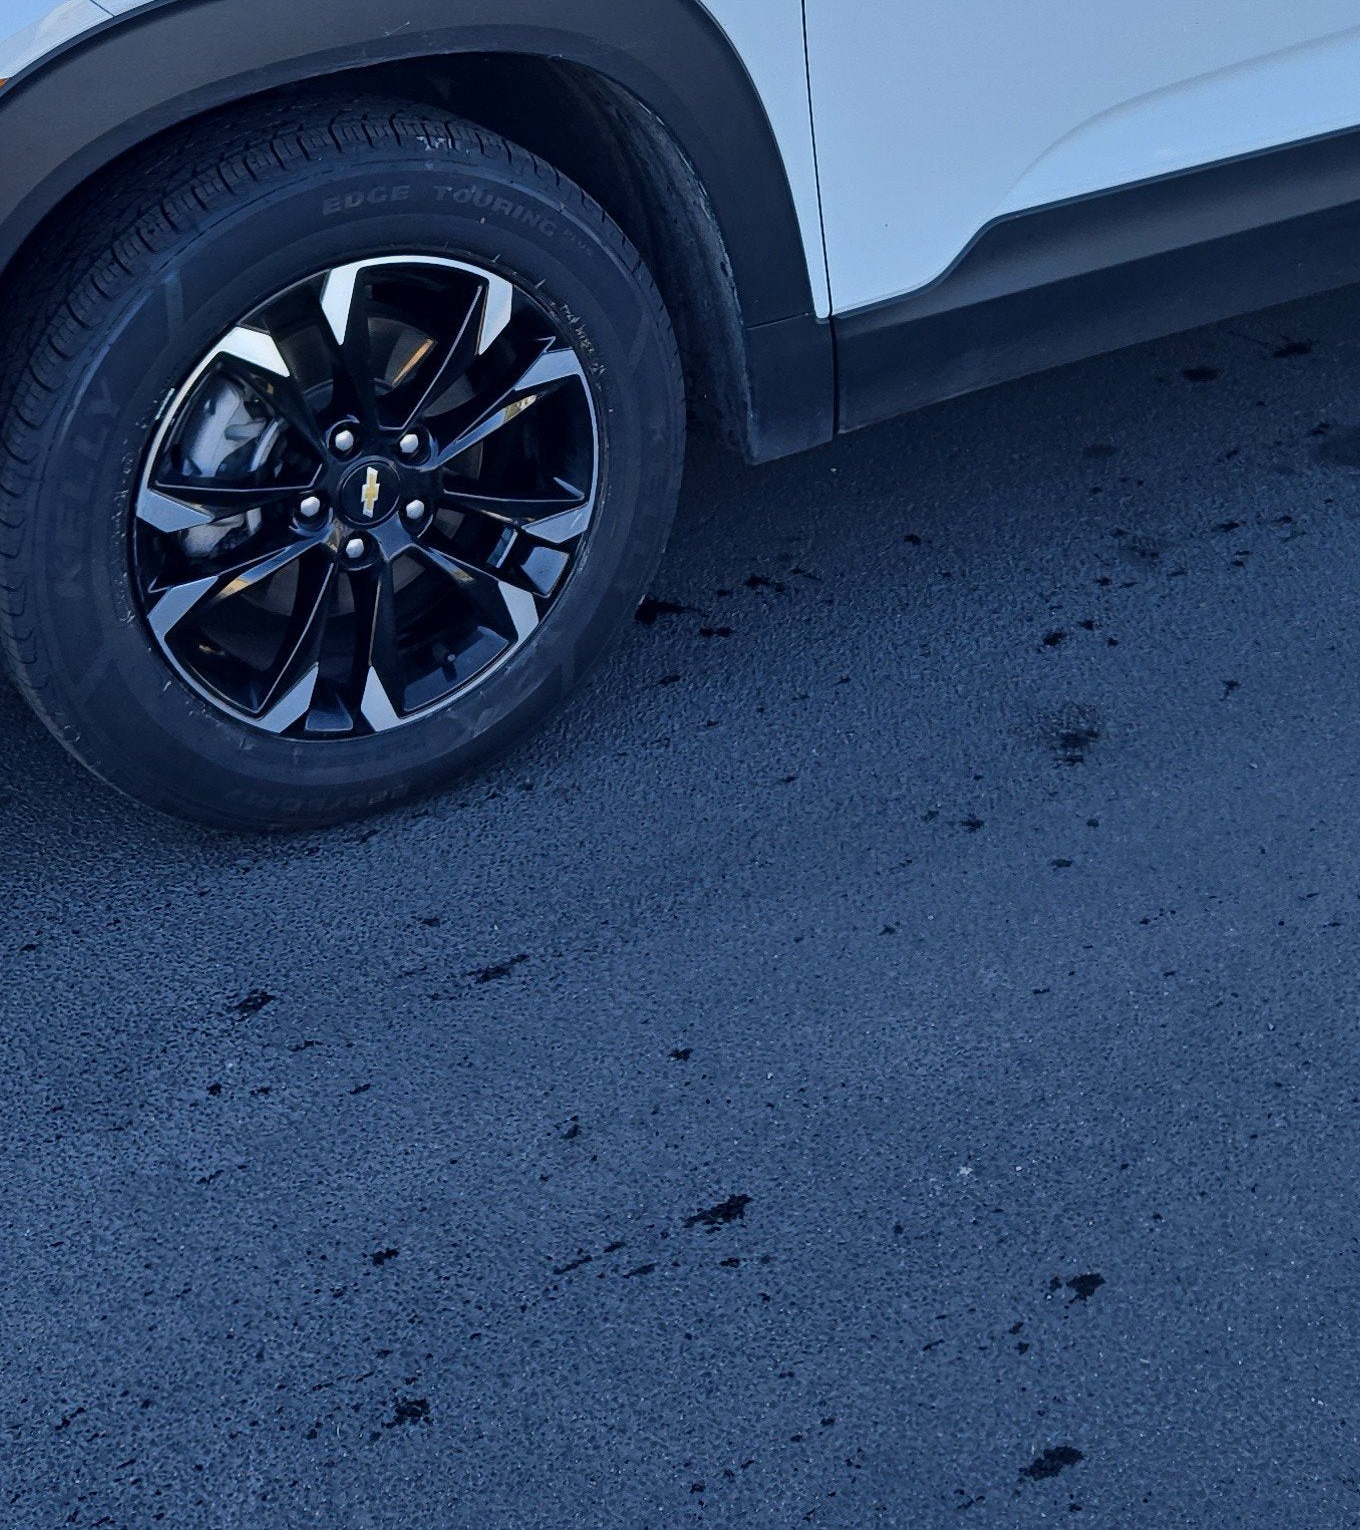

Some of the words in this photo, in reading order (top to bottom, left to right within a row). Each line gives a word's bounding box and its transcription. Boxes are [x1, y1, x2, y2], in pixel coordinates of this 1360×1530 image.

[322, 184, 410, 216] EDGE
[434, 185, 558, 238] TOURING
[54, 376, 122, 597] KELLY
